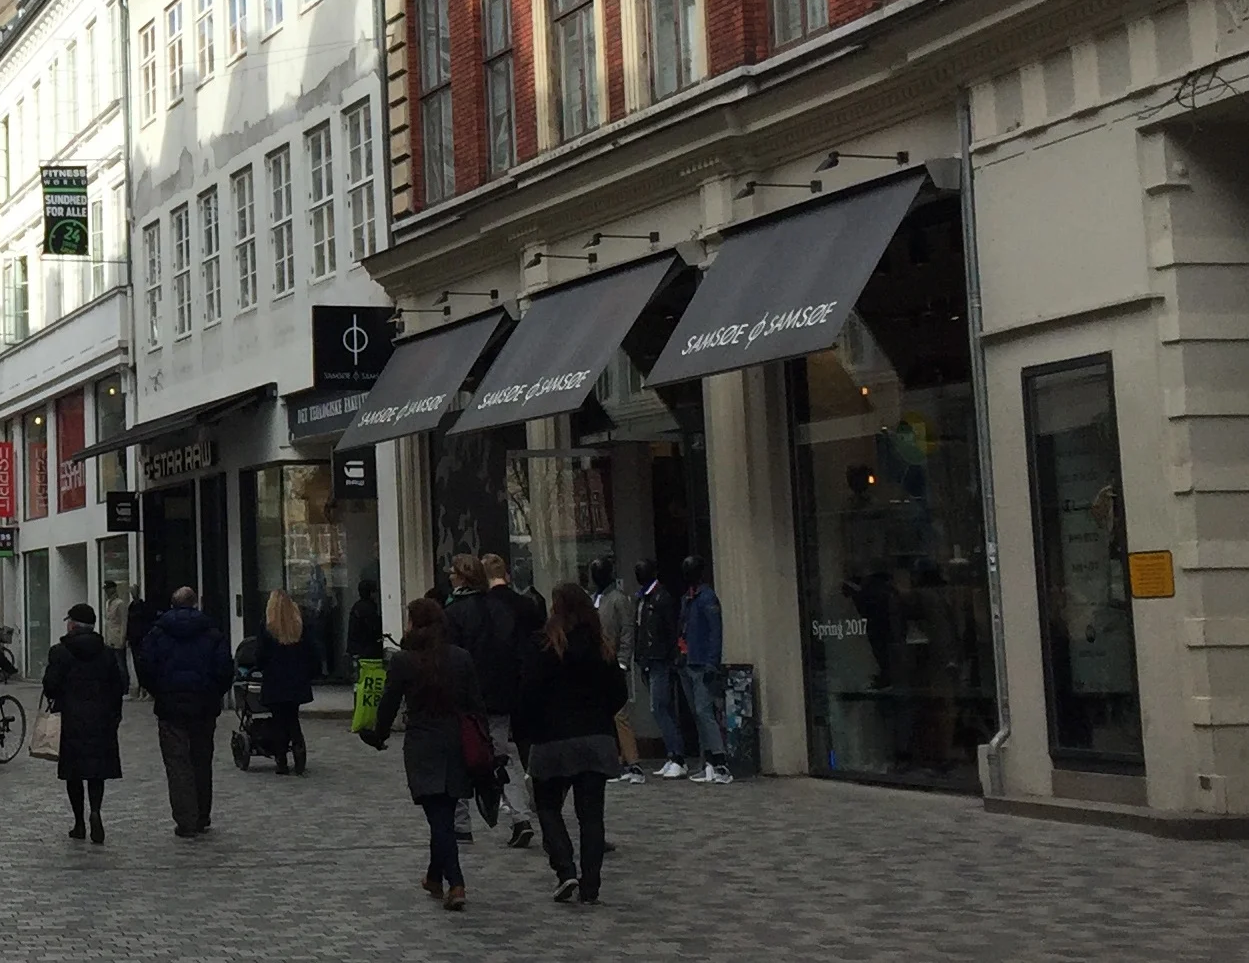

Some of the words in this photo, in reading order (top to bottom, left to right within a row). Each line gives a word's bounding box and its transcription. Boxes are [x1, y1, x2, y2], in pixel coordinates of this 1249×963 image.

[42, 169, 86, 178] FITNESS
[46, 206, 64, 217] FOR
[66, 207, 87, 217] ALLE
[764, 301, 838, 336] SAMSØE
[184, 440, 212, 470] RAW
[812, 619, 844, 639] Spring
[845, 618, 868, 635] 2017
[364, 676, 384, 690] RE
